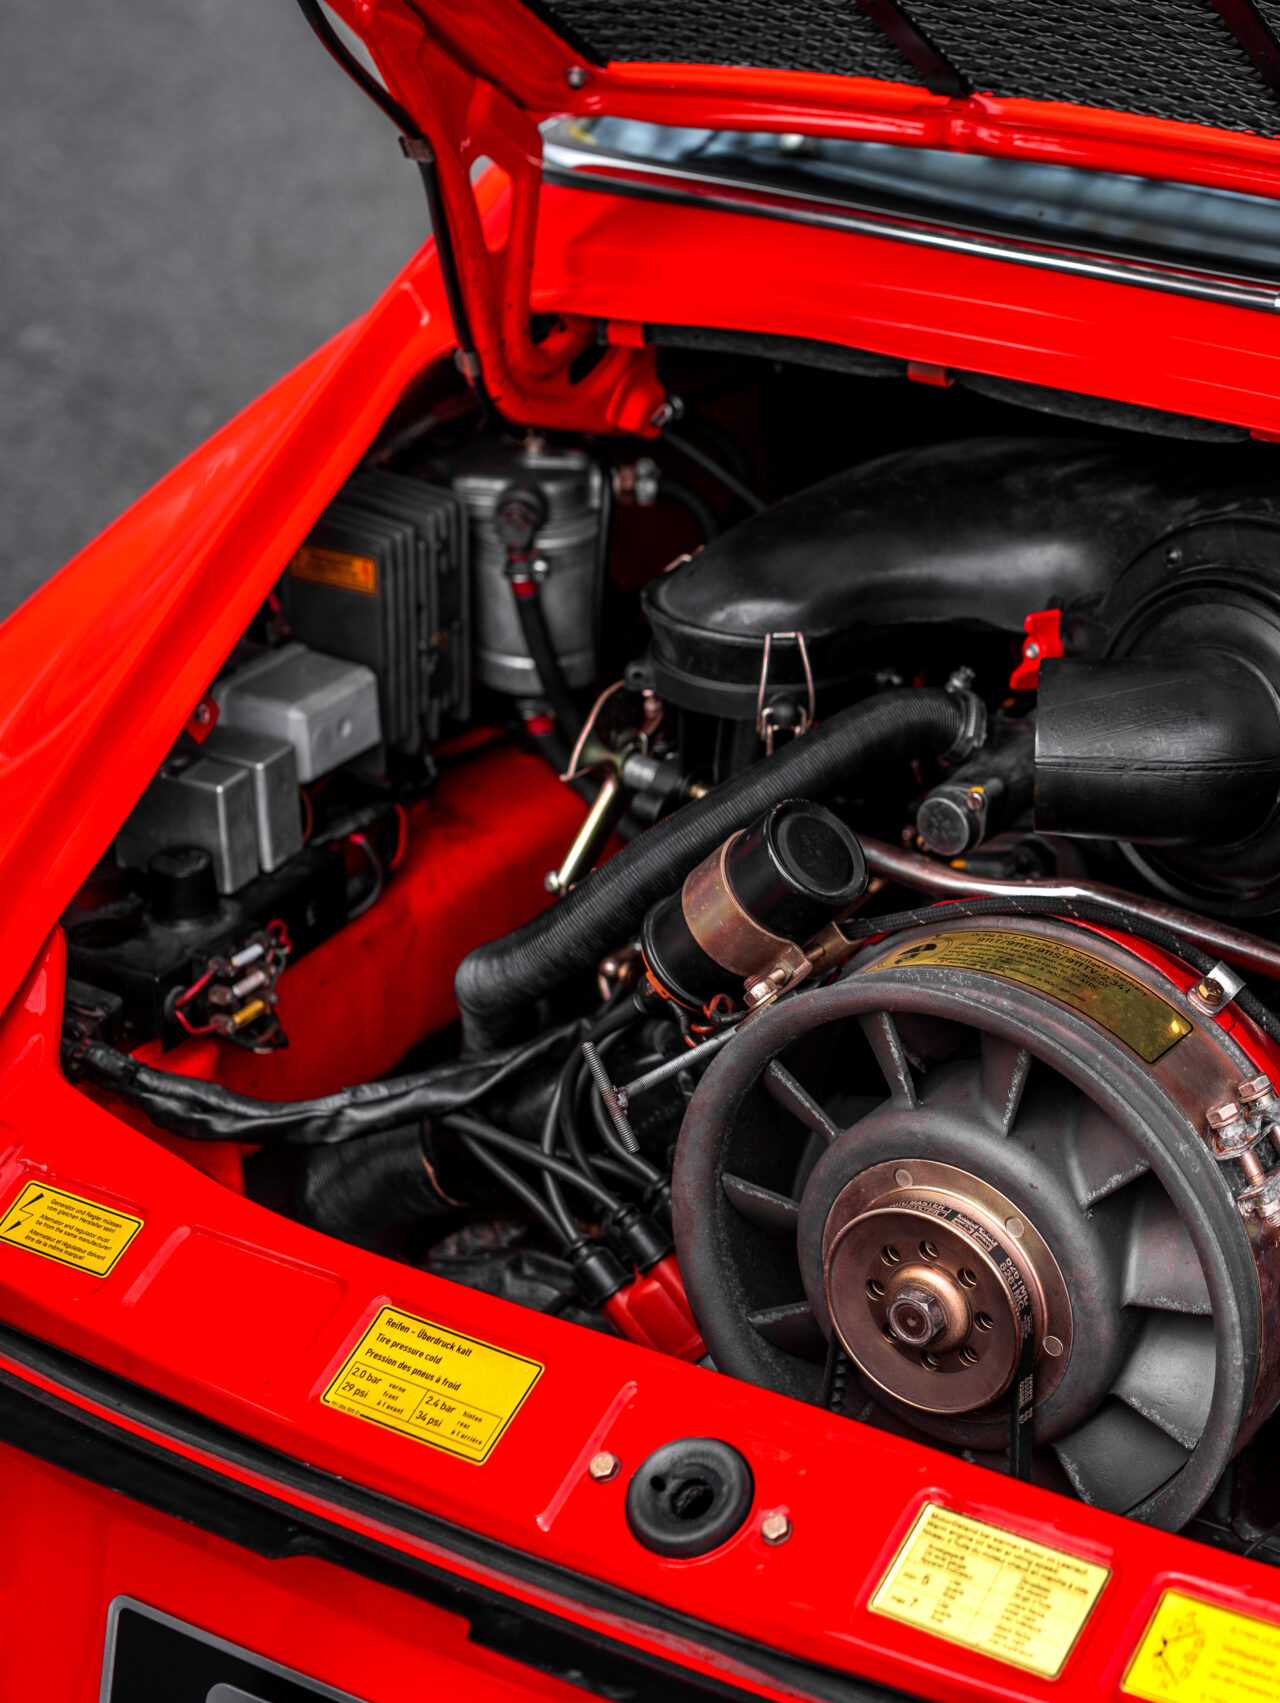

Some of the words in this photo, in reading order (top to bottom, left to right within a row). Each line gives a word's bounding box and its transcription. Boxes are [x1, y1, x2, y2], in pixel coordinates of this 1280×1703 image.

[40, 1213, 64, 1226] Alternator
[74, 1226, 97, 1238] regulator
[47, 1205, 58, 1213] vom
[57, 1209, 79, 1220] gleichen
[79, 1216, 103, 1229] Hersteller
[50, 1198, 76, 1211] Generator
[86, 1211, 103, 1222] Regler
[102, 1218, 122, 1229] müssen
[43, 1222, 55, 1230] from
[64, 1230, 78, 1239] same
[24, 1234, 35, 1242] être
[48, 1243, 64, 1253] même
[29, 1228, 56, 1242] Alternateur
[61, 1240, 87, 1254] régulateur
[87, 1250, 106, 1261] doivent
[376, 1332, 391, 1345] Tire
[390, 1341, 425, 1358] pressure
[425, 1354, 443, 1365] cold
[385, 1317, 410, 1334] Reifen
[416, 1328, 457, 1352] Überdruck
[456, 1344, 473, 1357] kalt
[351, 1367, 367, 1379] 2.0
[366, 1371, 382, 1385] bar
[365, 1347, 398, 1367] Pression
[398, 1360, 412, 1372] des
[411, 1368, 435, 1382] pneus
[434, 1375, 440, 1384] à
[441, 1378, 462, 1392] froid
[341, 1381, 355, 1392] 29
[352, 1388, 370, 1399] psi
[388, 1383, 406, 1393] vorne
[425, 1395, 440, 1408] 2.4
[440, 1401, 456, 1413] bar
[382, 1390, 399, 1401] front
[462, 1410, 483, 1423] hinten
[415, 1410, 428, 1422] 34
[426, 1417, 444, 1427] psi
[456, 1420, 471, 1430] rear
